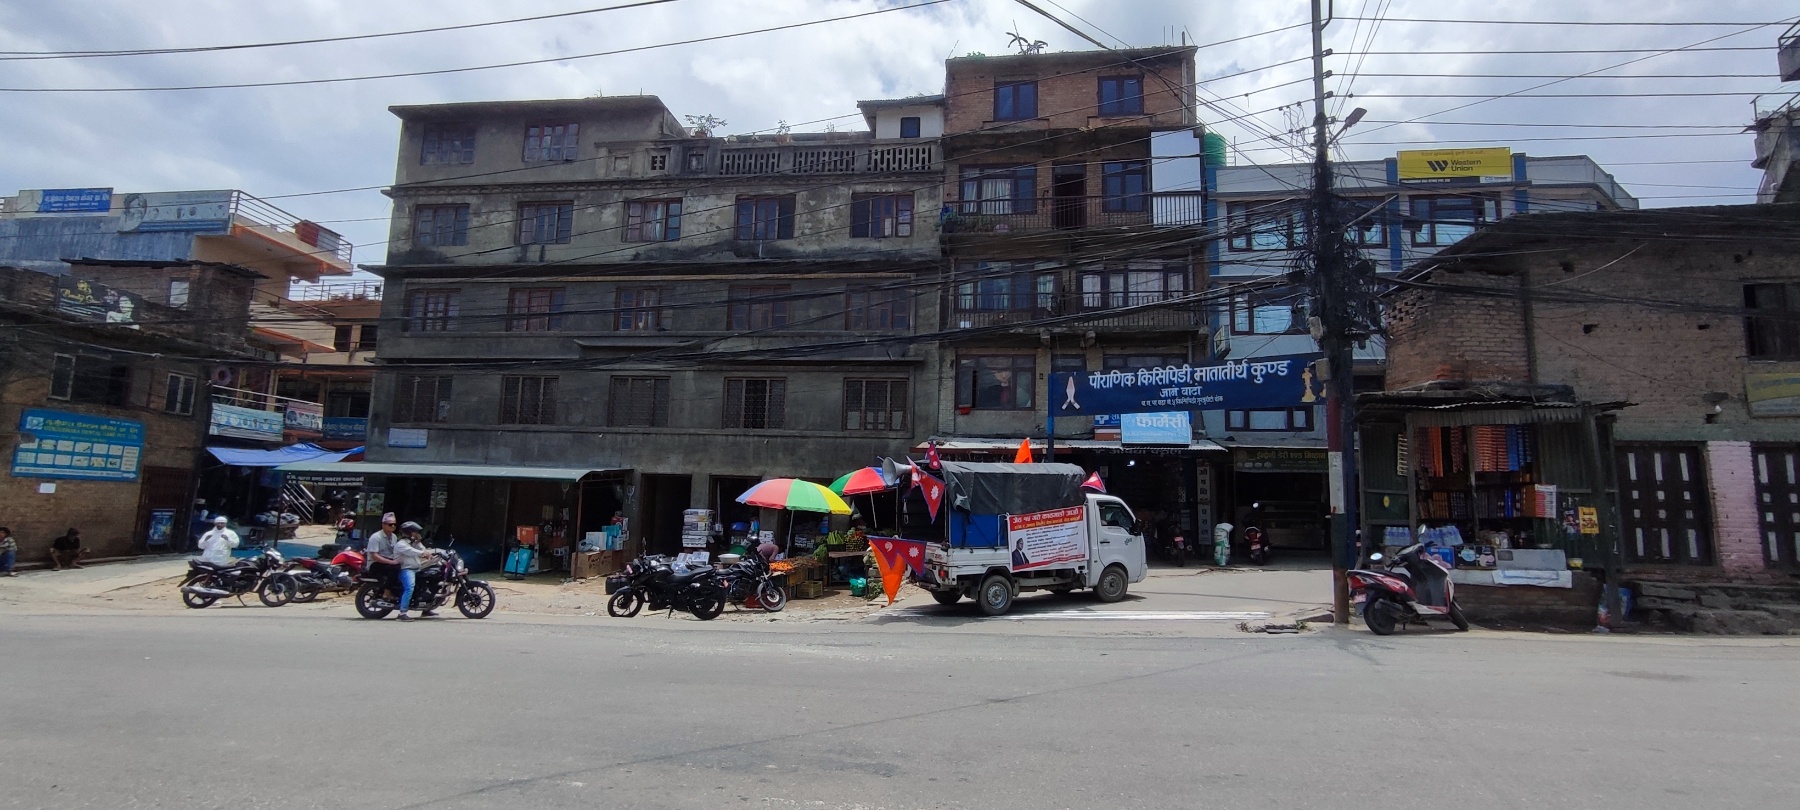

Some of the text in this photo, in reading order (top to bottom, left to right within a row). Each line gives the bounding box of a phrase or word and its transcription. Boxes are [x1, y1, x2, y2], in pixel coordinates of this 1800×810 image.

[1088, 370, 1136, 388] पौराणिक
[1194, 360, 1249, 381] मातातीर्थ
[1251, 360, 1291, 383] कुण्ड
